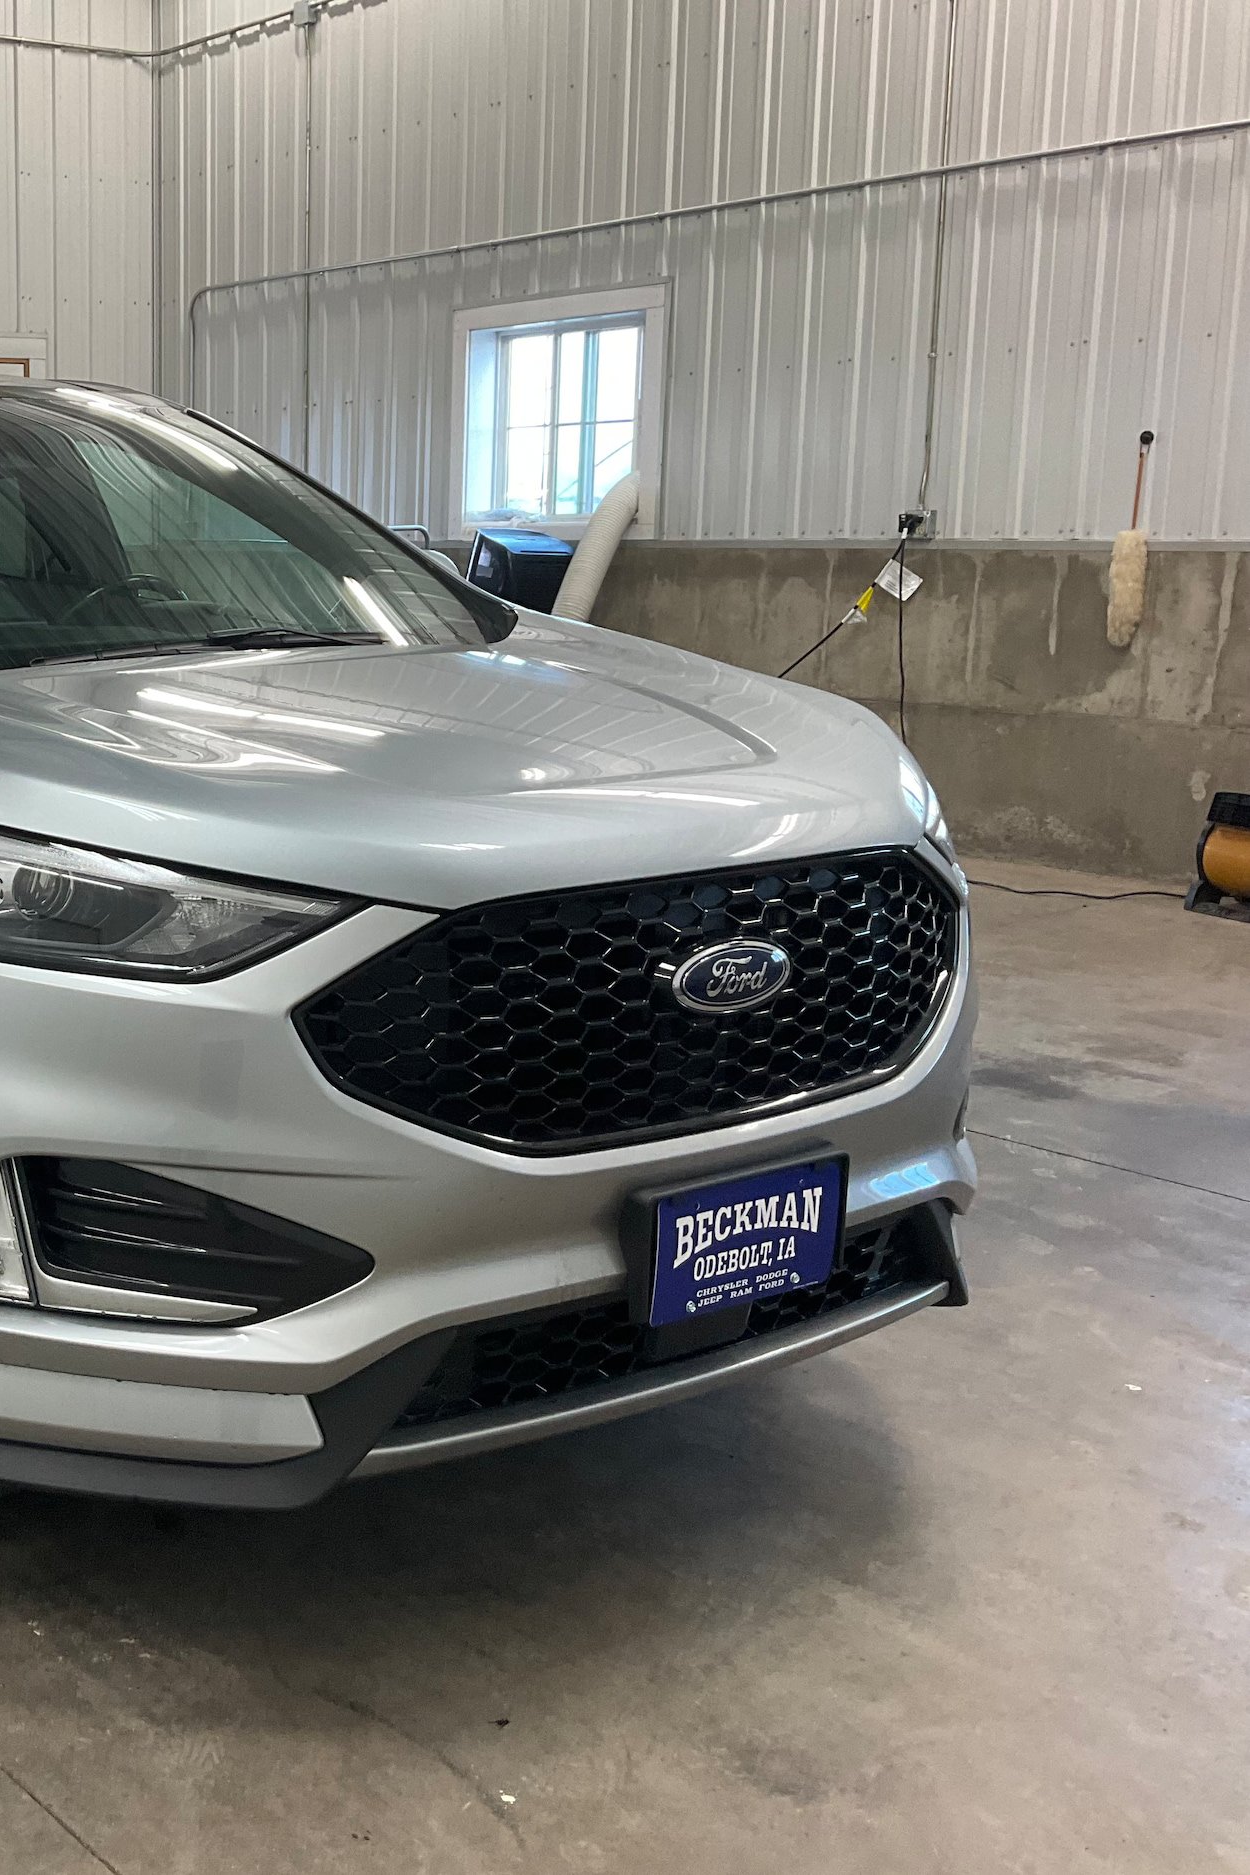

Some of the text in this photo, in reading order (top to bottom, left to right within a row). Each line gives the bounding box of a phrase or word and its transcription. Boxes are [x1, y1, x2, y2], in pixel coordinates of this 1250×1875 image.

[706, 955, 768, 997] Ford
[673, 1186, 823, 1269] BECKMAN
[693, 1235, 796, 1281] ODEBOLT, IA
[696, 1268, 789, 1298] CHRYSLER DODGE
[697, 1294, 723, 1307] JEEP
[730, 1286, 753, 1299] RAM
[758, 1279, 785, 1292] FORD
